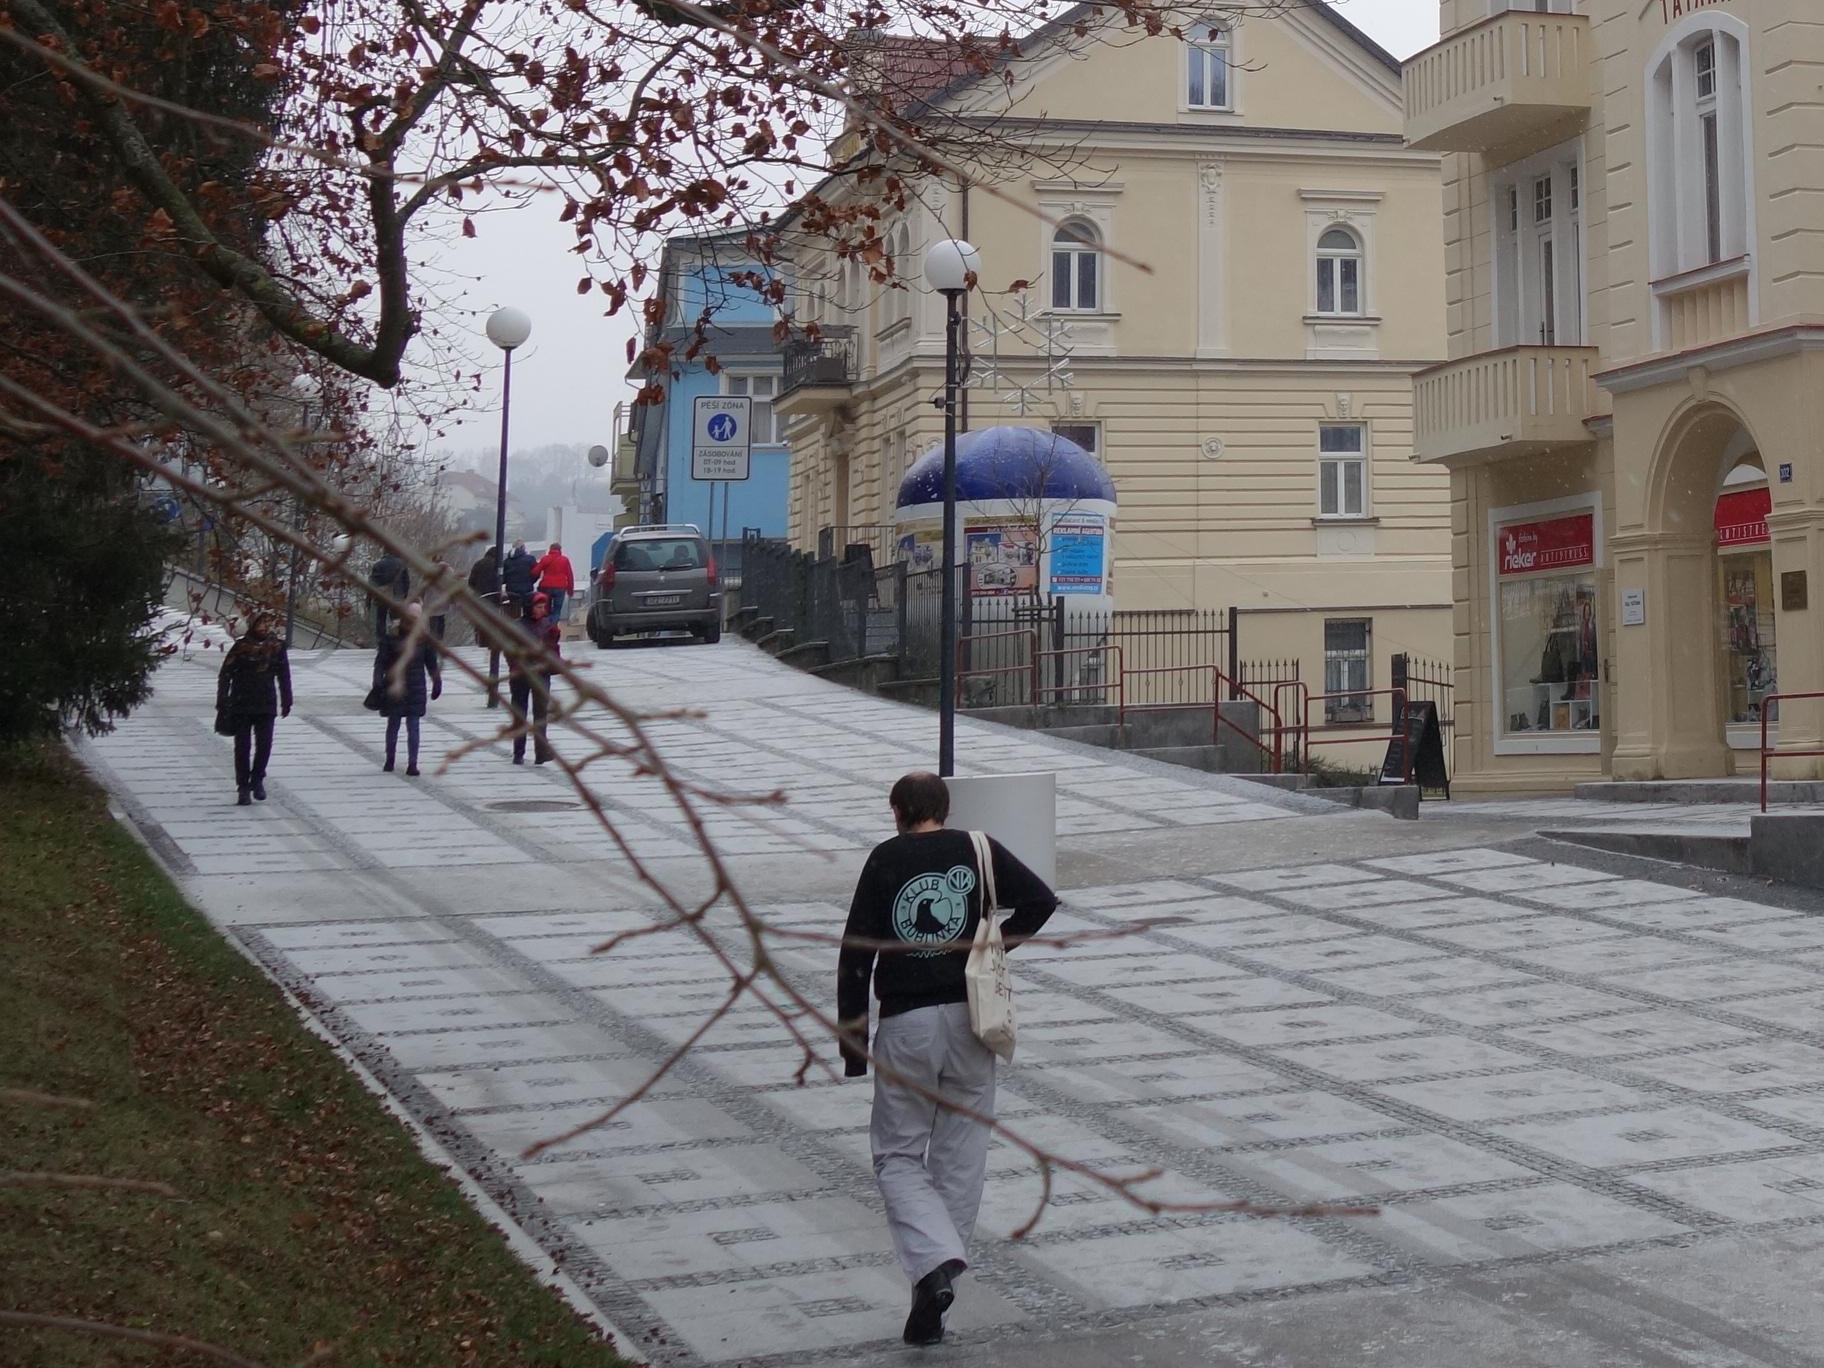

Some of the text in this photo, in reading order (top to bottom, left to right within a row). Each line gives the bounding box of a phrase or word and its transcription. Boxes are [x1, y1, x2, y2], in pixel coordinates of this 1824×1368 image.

[721, 400, 745, 410] ZÓNA
[1719, 522, 1769, 540] ANTISTRE
[1504, 547, 1538, 571] rieker
[902, 878, 940, 904] KLUB
